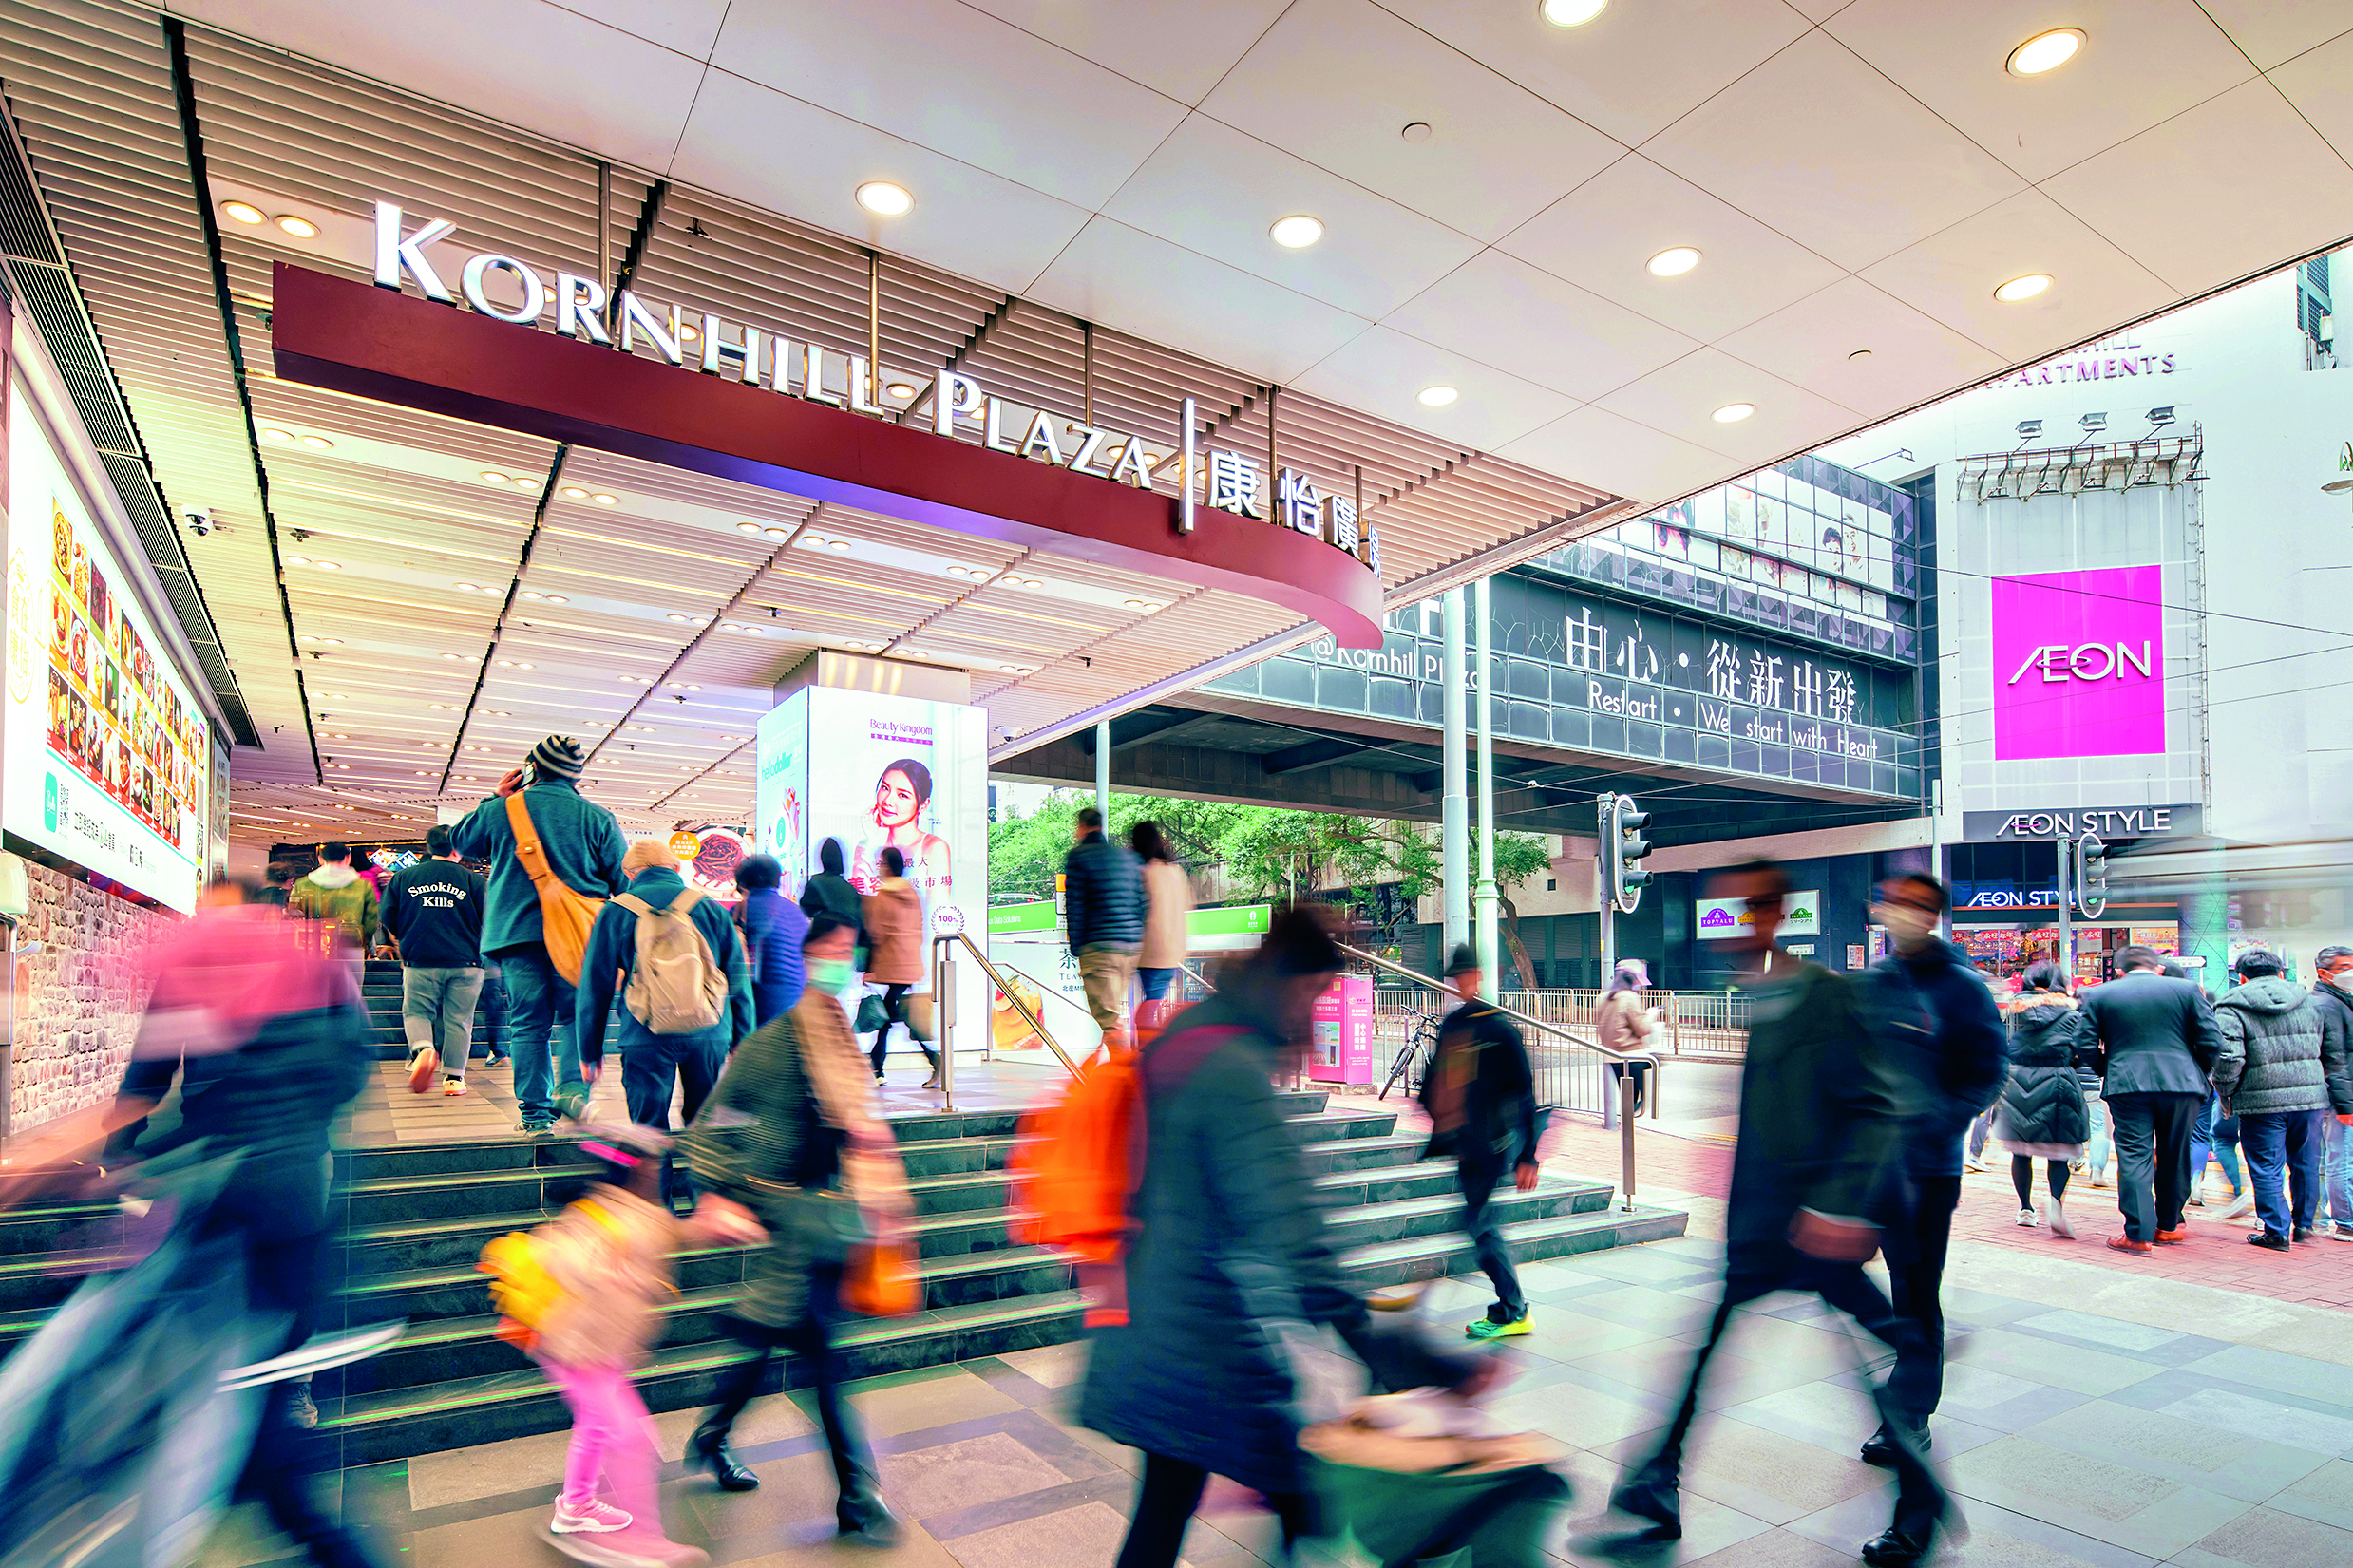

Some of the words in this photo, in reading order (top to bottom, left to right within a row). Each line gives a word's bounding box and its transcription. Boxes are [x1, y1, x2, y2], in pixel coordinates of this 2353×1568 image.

[374, 199, 884, 419] KORNHILL
[932, 368, 1152, 491] PLAZA
[1985, 353, 2176, 389] ARTMENTS
[870, 718, 899, 735] Beauty
[900, 722, 933, 737] Kingdom
[1588, 680, 1657, 720] Restart
[1699, 701, 1730, 733] We
[1746, 720, 1783, 744] start
[1793, 725, 1833, 751] with
[1837, 728, 1878, 760] Heart
[2081, 809, 2172, 834] STYLE
[408, 881, 467, 901] Smoking
[2028, 890, 2077, 907] STL
[422, 896, 454, 908] Kills
[938, 915, 958, 923] 100%
[1059, 948, 1078, 969] 茶
